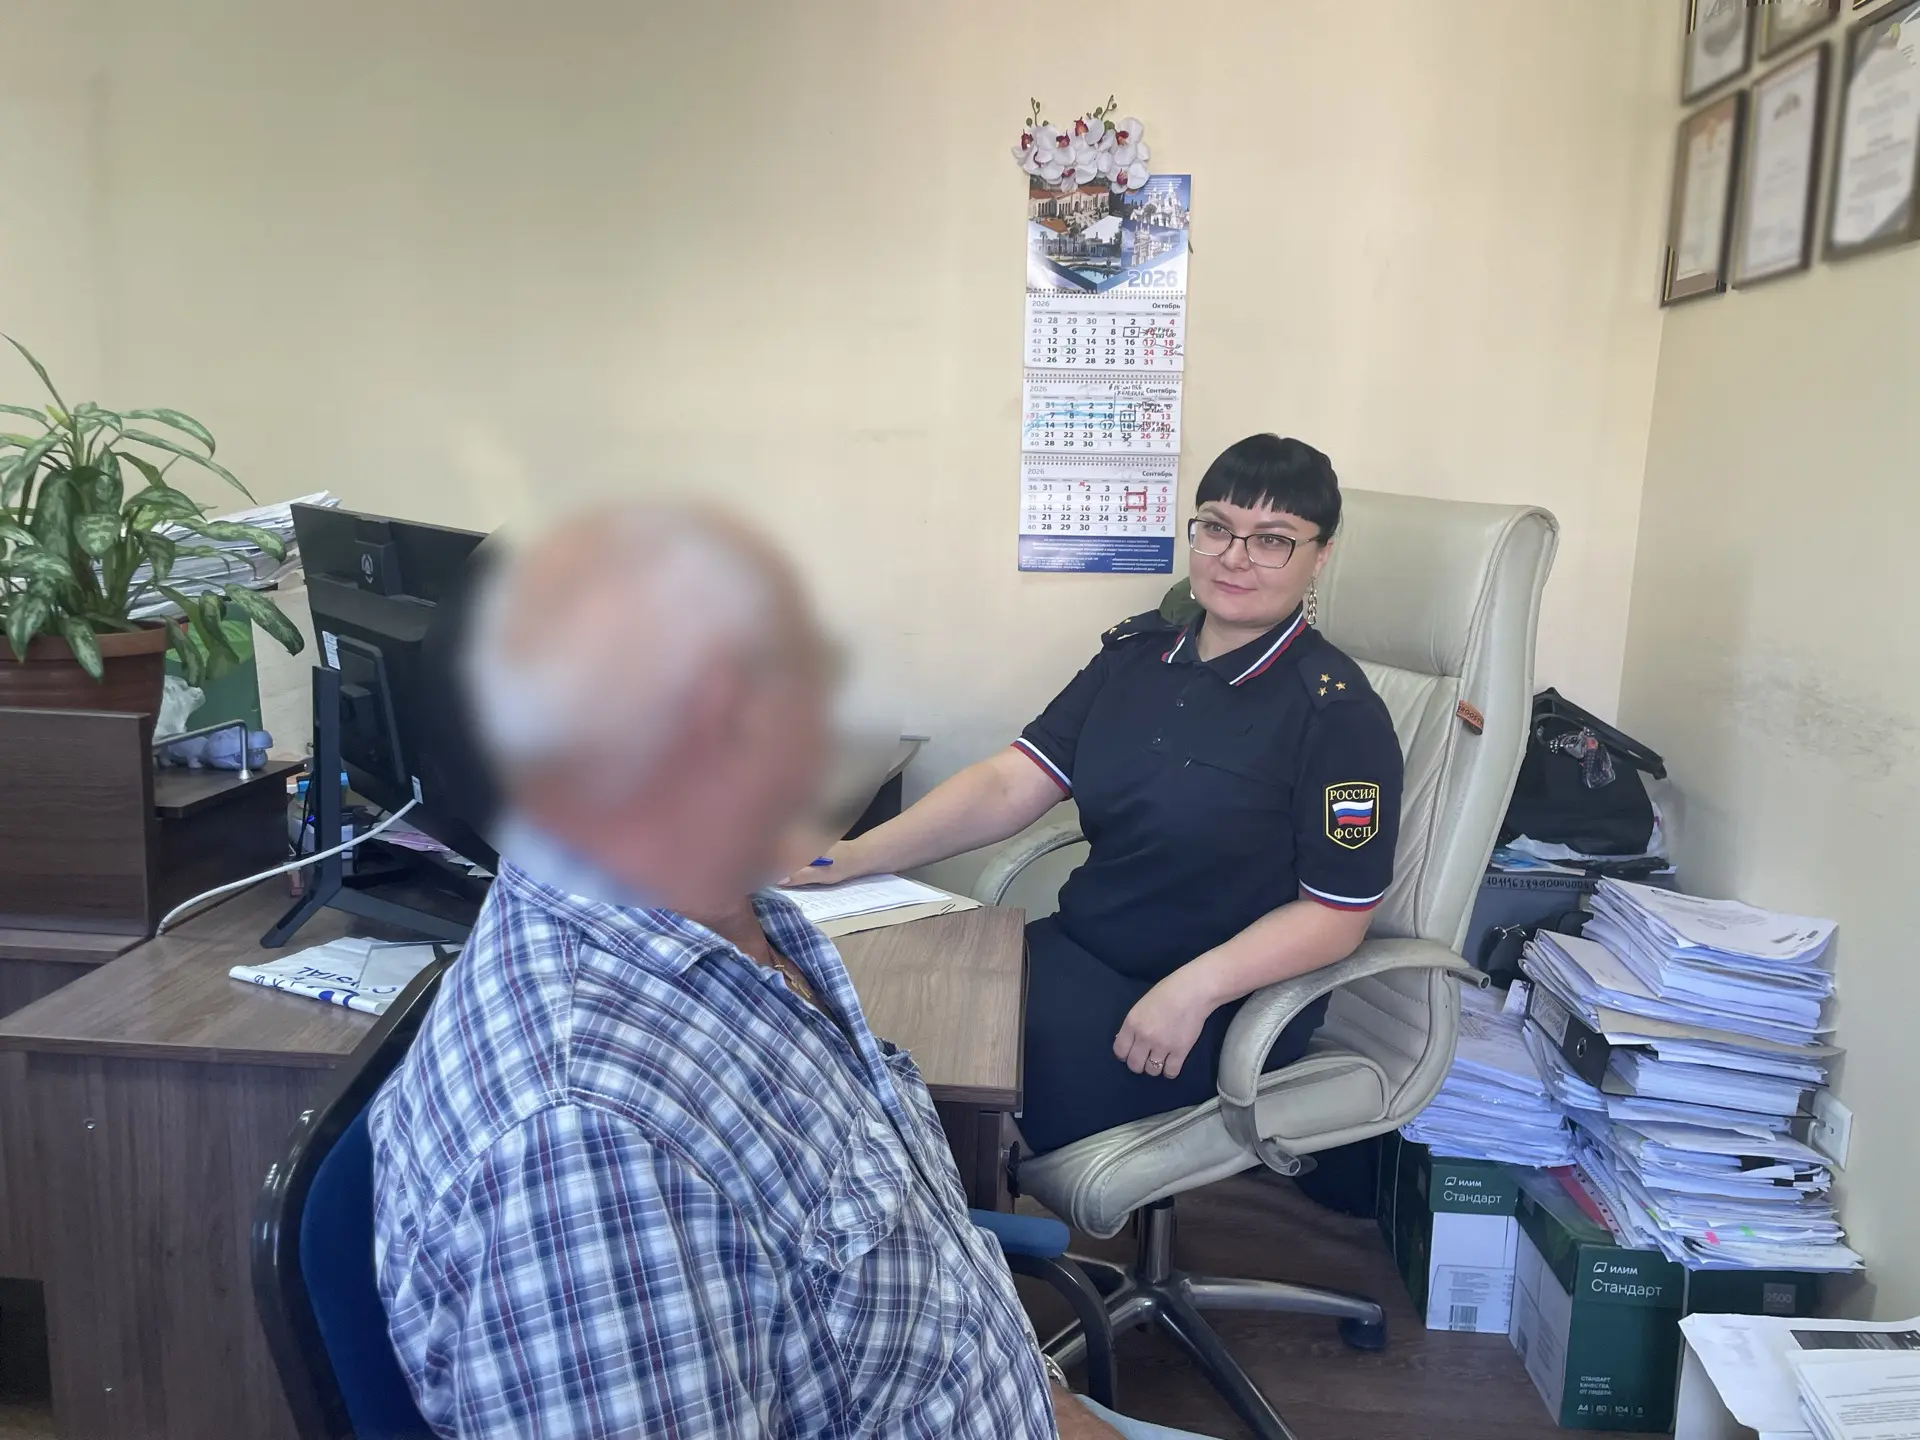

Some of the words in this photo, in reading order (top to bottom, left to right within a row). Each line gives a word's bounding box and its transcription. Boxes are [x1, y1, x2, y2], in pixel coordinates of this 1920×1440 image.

[1128, 270, 1178, 287] 2026
[1330, 788, 1376, 800] РОССИЯ
[1334, 826, 1372, 839] ФССП
[1444, 1190, 1502, 1204] Стандарт
[1592, 1278, 1662, 1298] Стандарт
[1766, 1292, 1792, 1304] 2500
